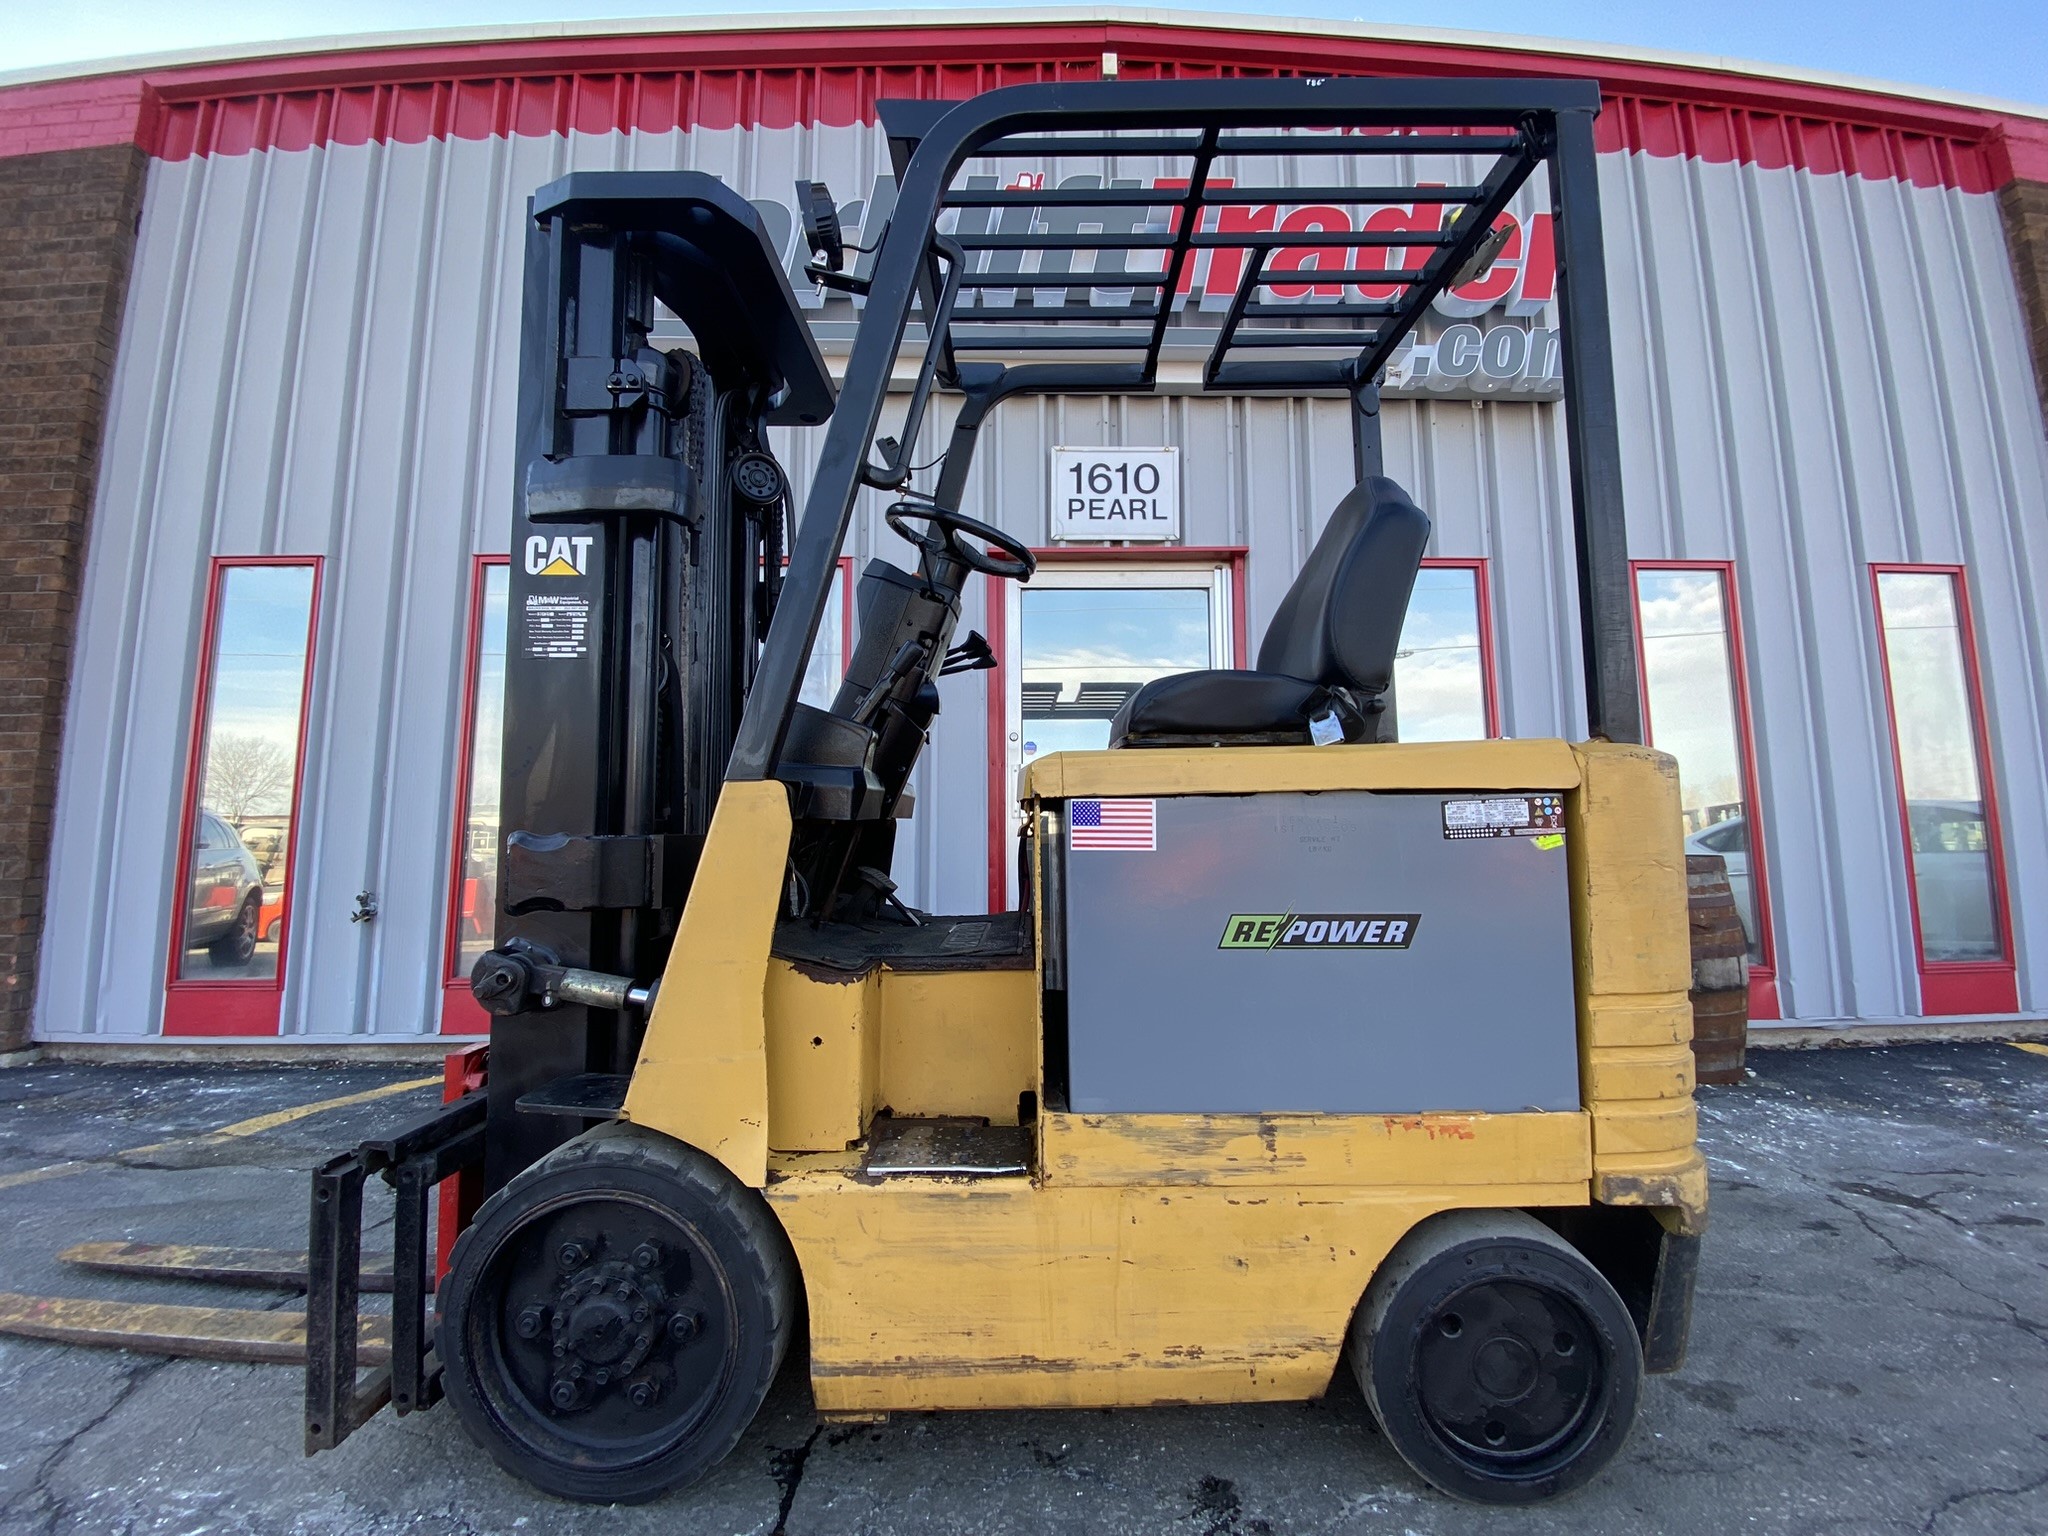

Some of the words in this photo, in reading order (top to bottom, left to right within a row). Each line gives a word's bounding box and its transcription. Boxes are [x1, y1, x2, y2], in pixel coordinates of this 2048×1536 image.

[1069, 462, 1160, 495] 1610
[1068, 498, 1168, 520] PEARL
[525, 535, 593, 575] CAT
